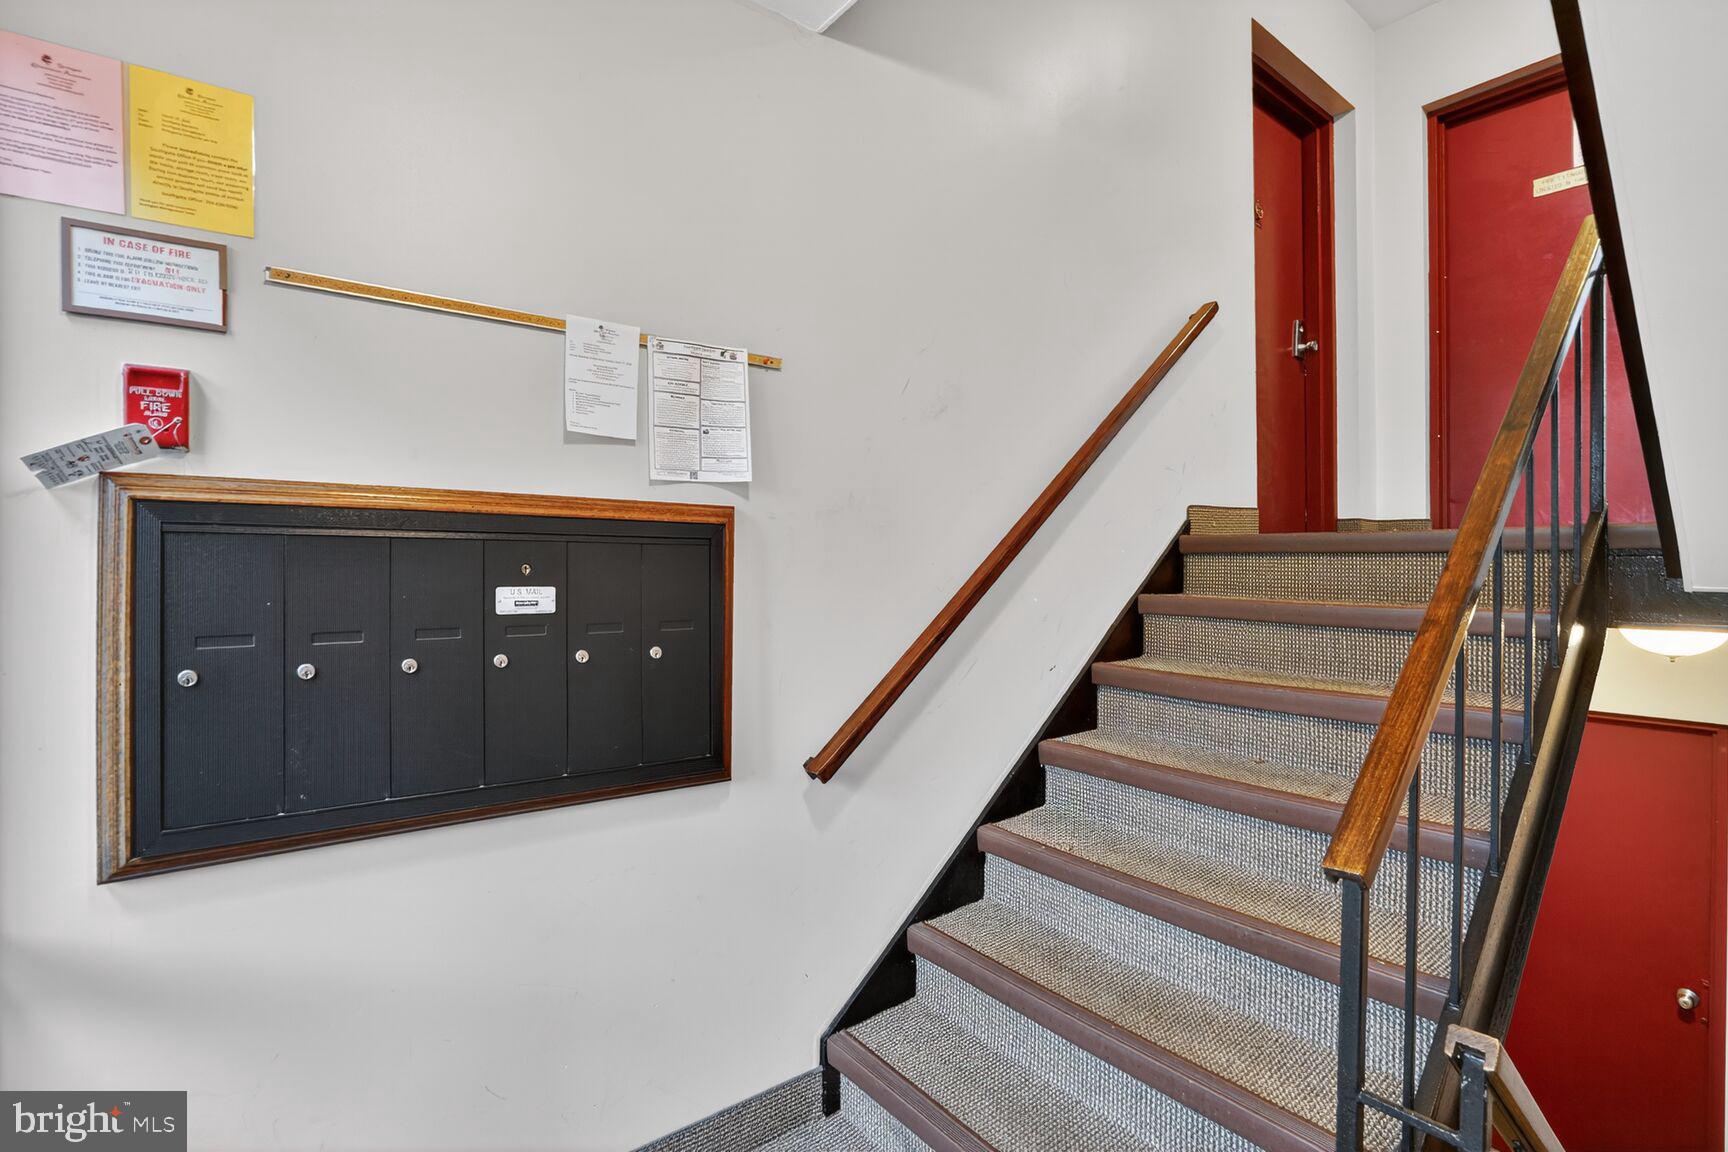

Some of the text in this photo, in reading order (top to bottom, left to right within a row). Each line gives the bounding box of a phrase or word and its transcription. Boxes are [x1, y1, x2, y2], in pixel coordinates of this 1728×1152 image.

[103, 236, 192, 260] IN CASE OF FIRE
[131, 277, 184, 291] EVACUATION
[186, 285, 207, 294] ONLY
[129, 386, 154, 395] PULL
[140, 401, 171, 412] FIRE
[525, 588, 544, 596] MAIL
